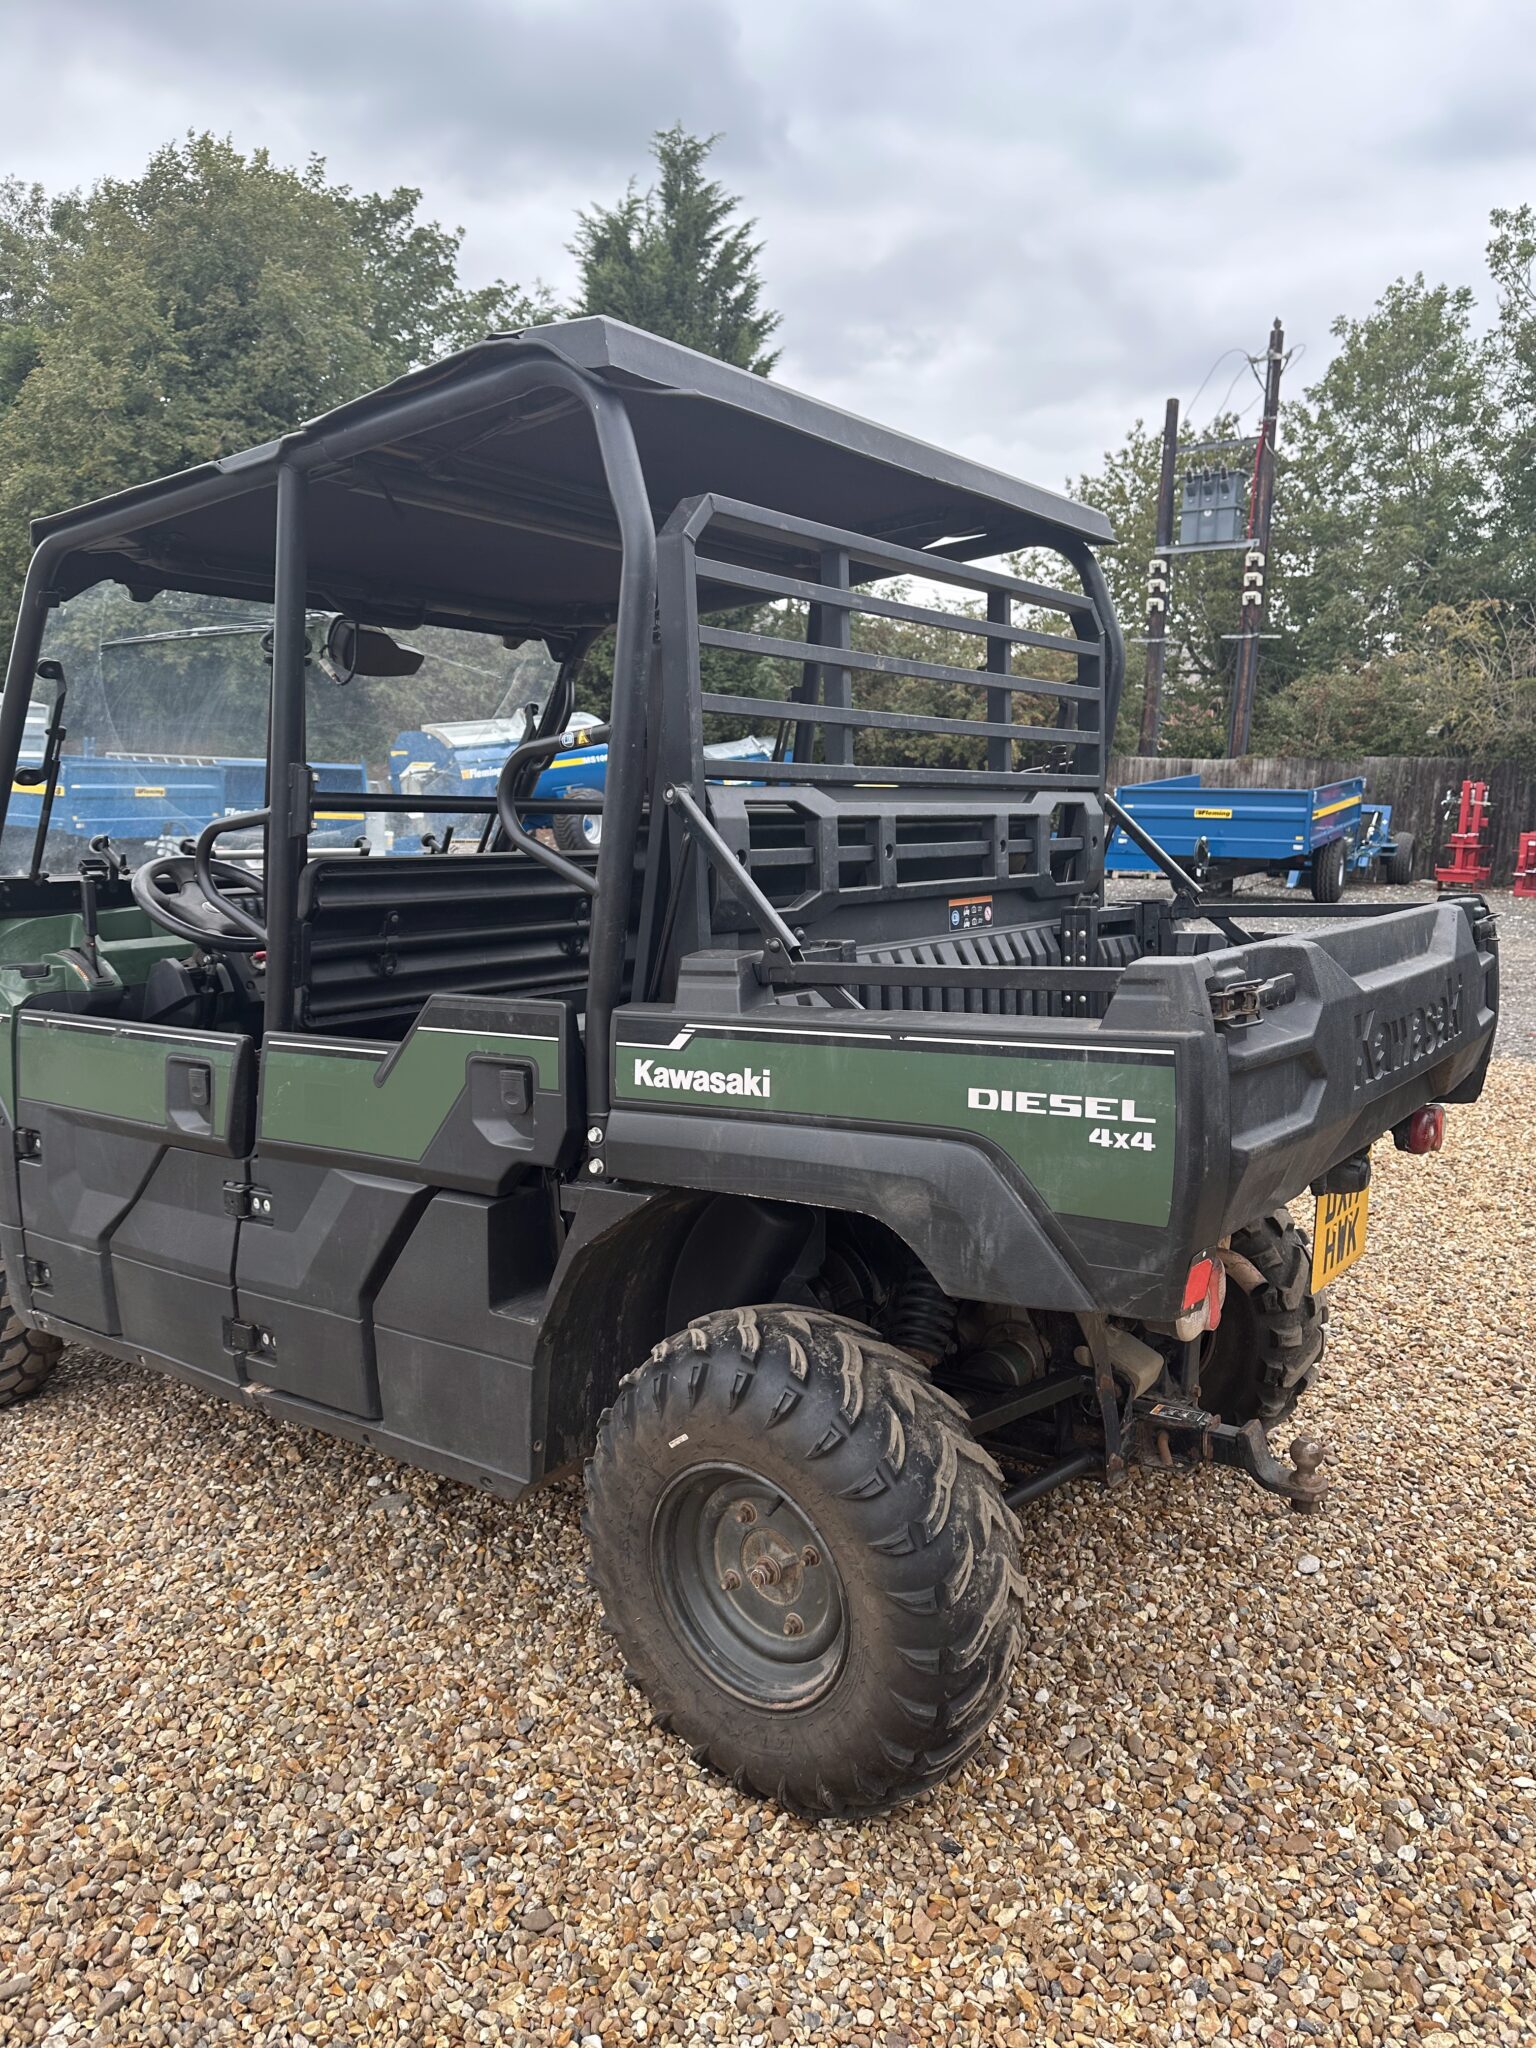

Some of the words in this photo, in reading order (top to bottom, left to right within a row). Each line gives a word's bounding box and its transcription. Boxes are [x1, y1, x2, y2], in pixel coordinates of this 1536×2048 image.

[1353, 973, 1463, 1091] Kawasaki
[634, 1058, 771, 1098] Kawasaki
[967, 1088, 1156, 1123] DIESEL
[1088, 1128, 1156, 1152] 4x4
[1323, 1207, 1359, 1275] HWK
